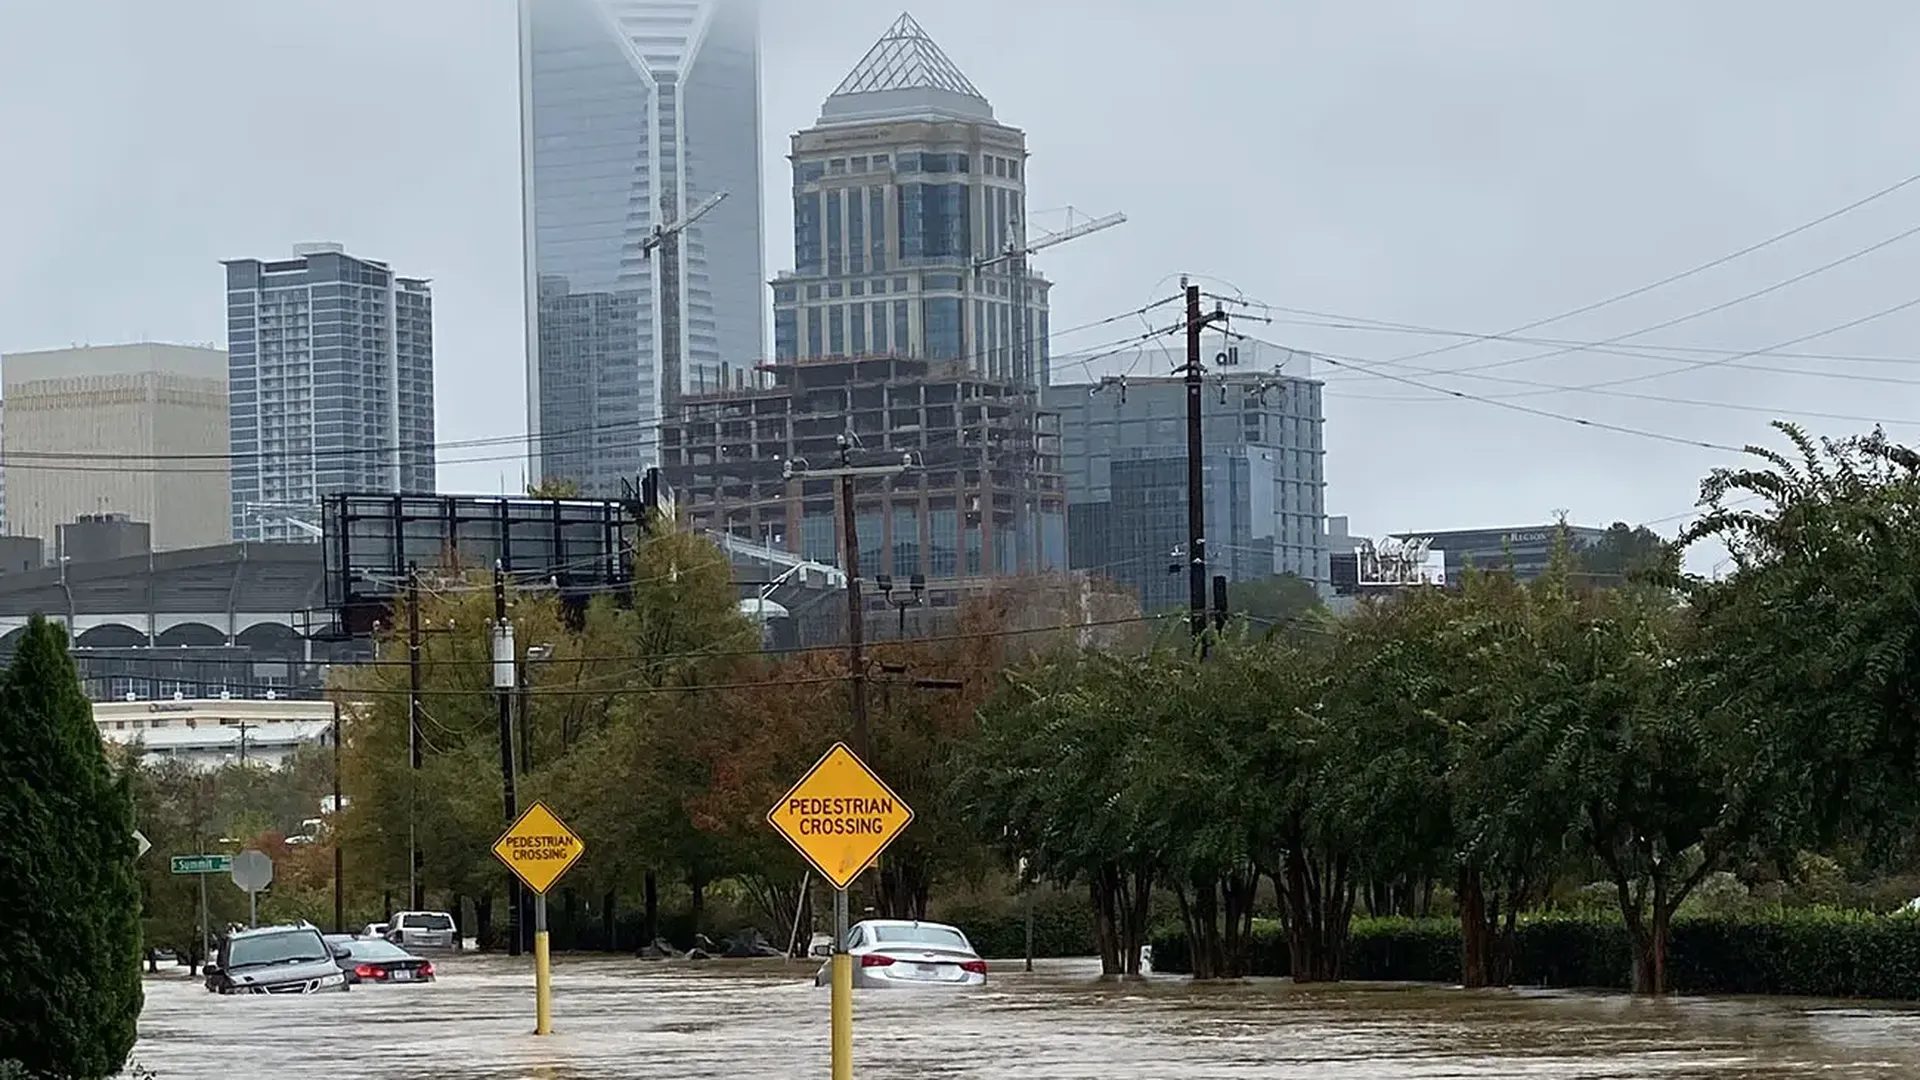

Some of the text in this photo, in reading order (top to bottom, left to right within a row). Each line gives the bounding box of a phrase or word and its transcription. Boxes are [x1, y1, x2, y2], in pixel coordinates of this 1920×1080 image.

[790, 798, 893, 815] PEDESTRIAN
[800, 817, 883, 835] CROSSING
[506, 836, 574, 848] PEDESTRIAN
[513, 848, 568, 861] CROSSING
[179, 859, 212, 870] Summit
